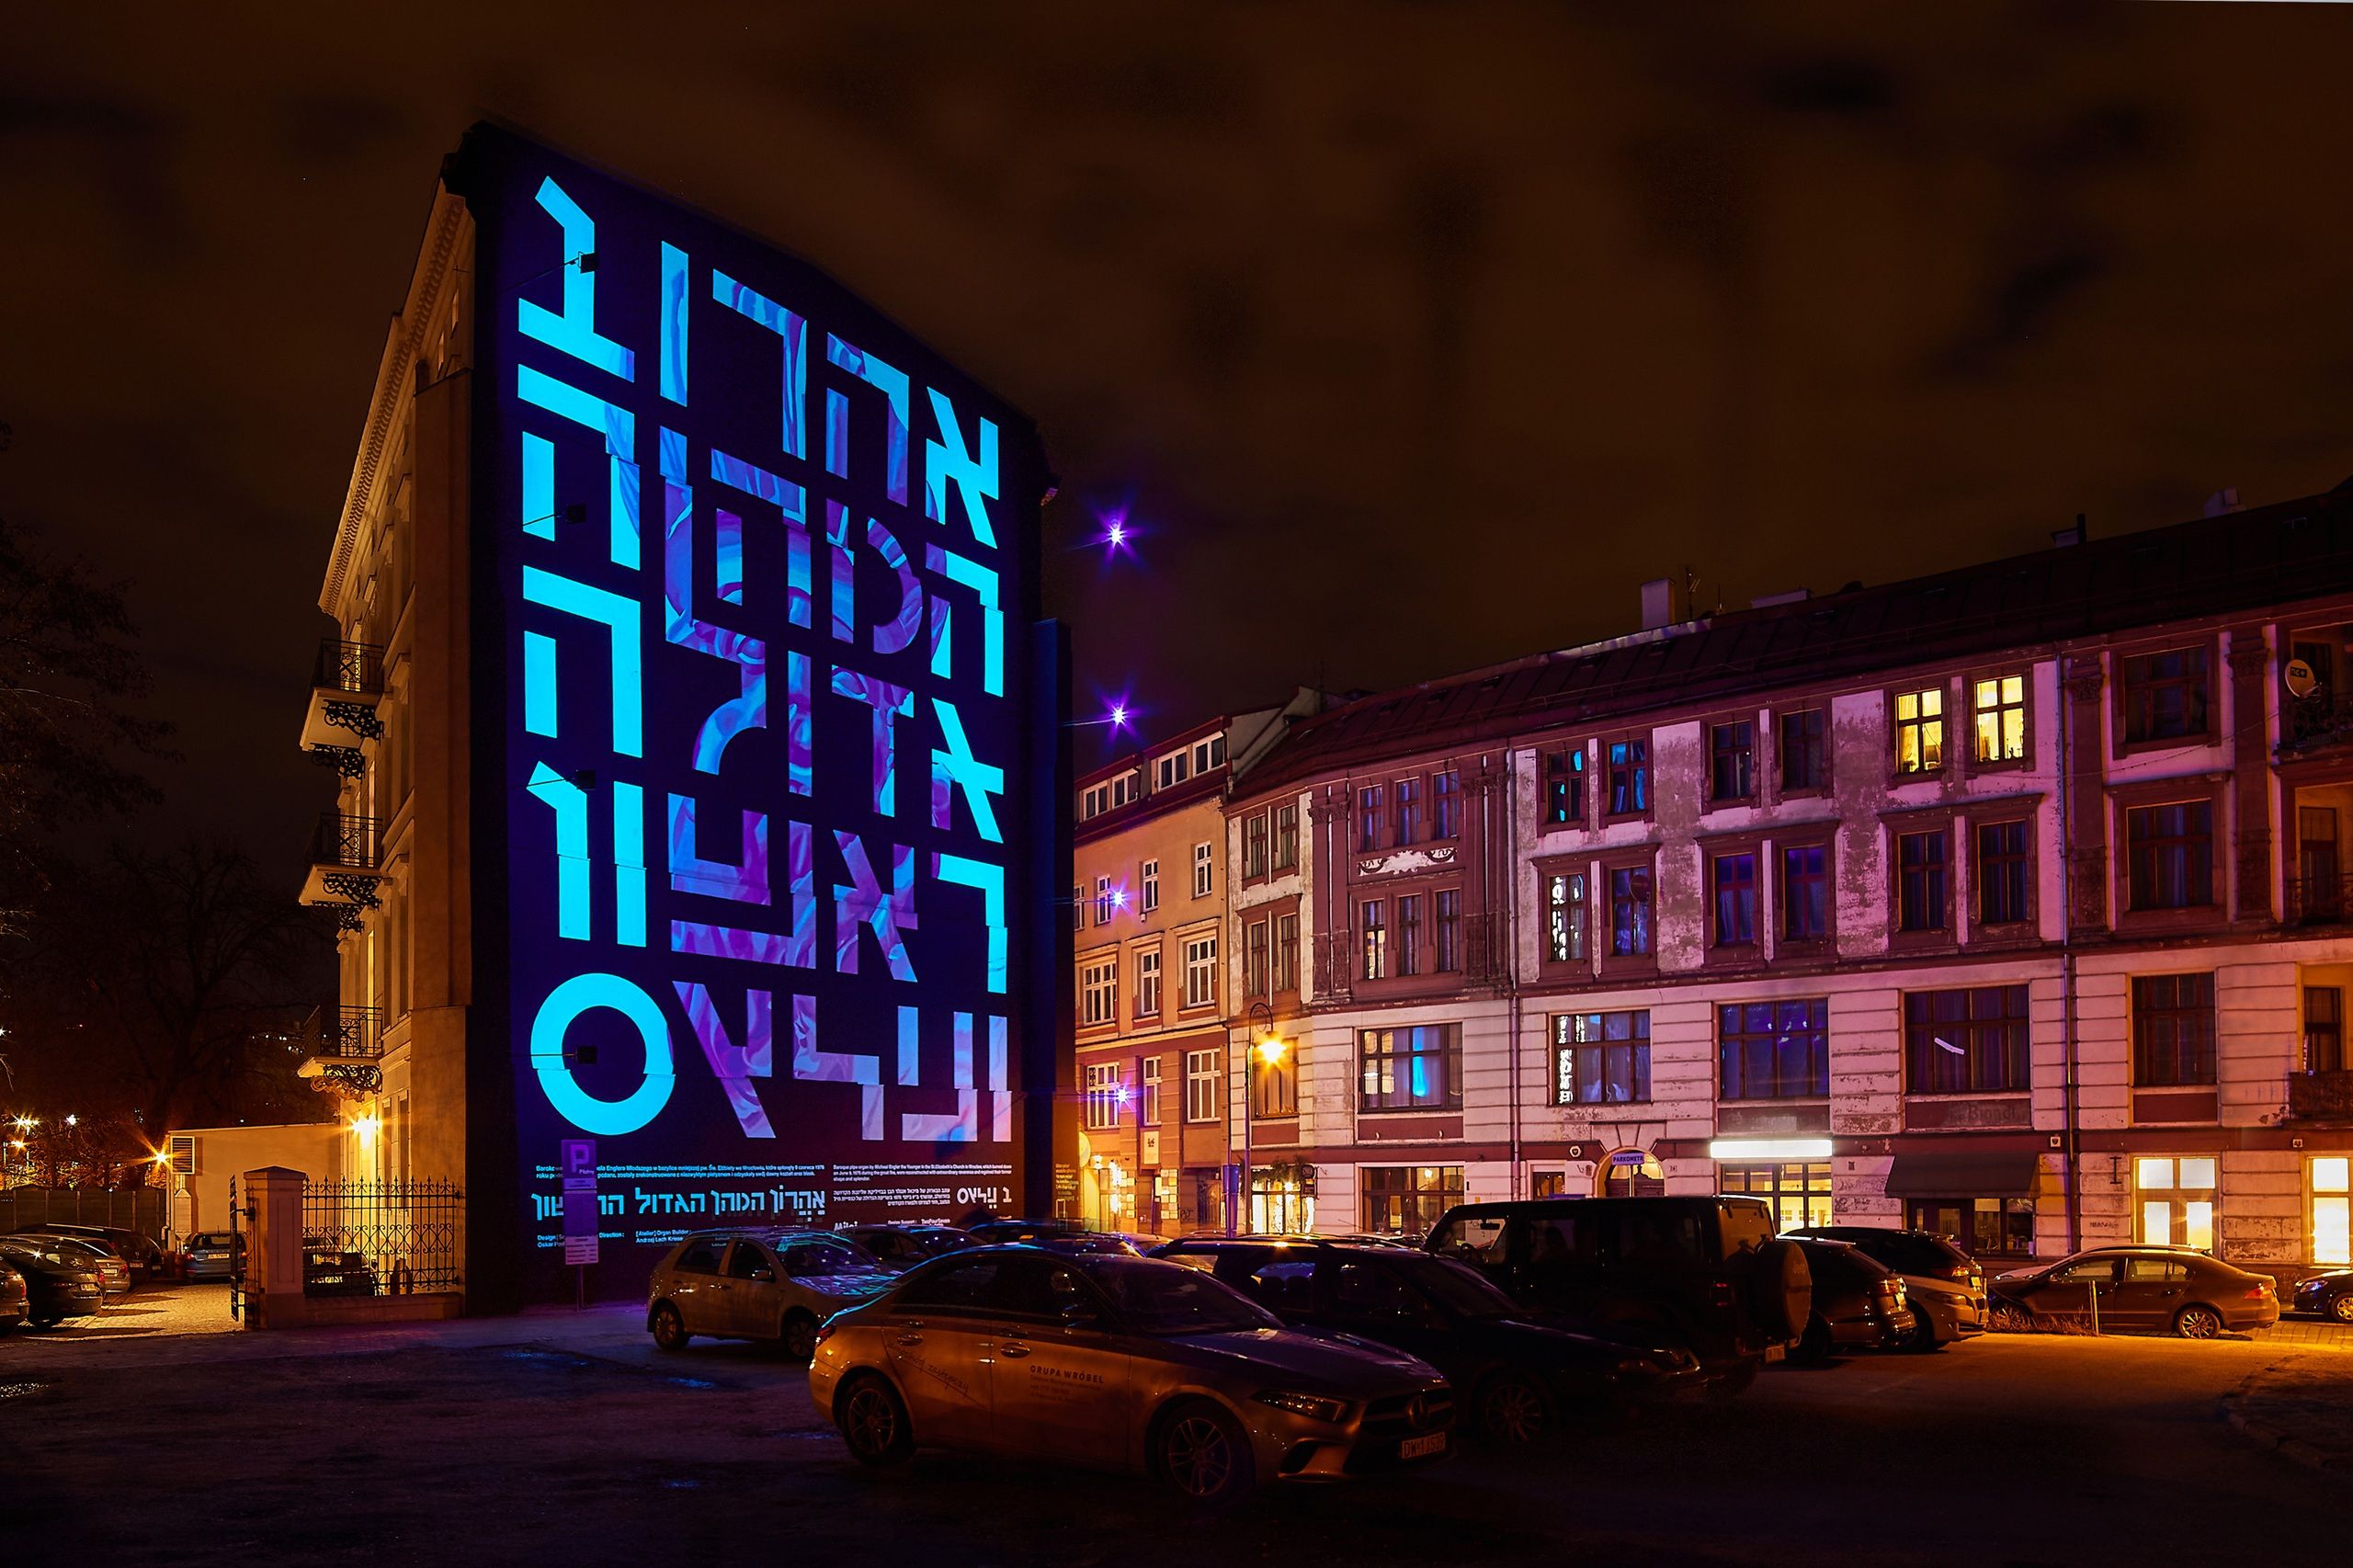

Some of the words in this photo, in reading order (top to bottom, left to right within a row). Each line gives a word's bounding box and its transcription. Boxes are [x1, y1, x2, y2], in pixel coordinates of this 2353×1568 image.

[2290, 667, 2306, 677] nc+
[571, 1144, 589, 1173] P
[635, 1187, 705, 1214] הגדול
[1030, 1365, 1061, 1377] GRUPA
[1064, 1370, 1104, 1384] WRÓBEL
